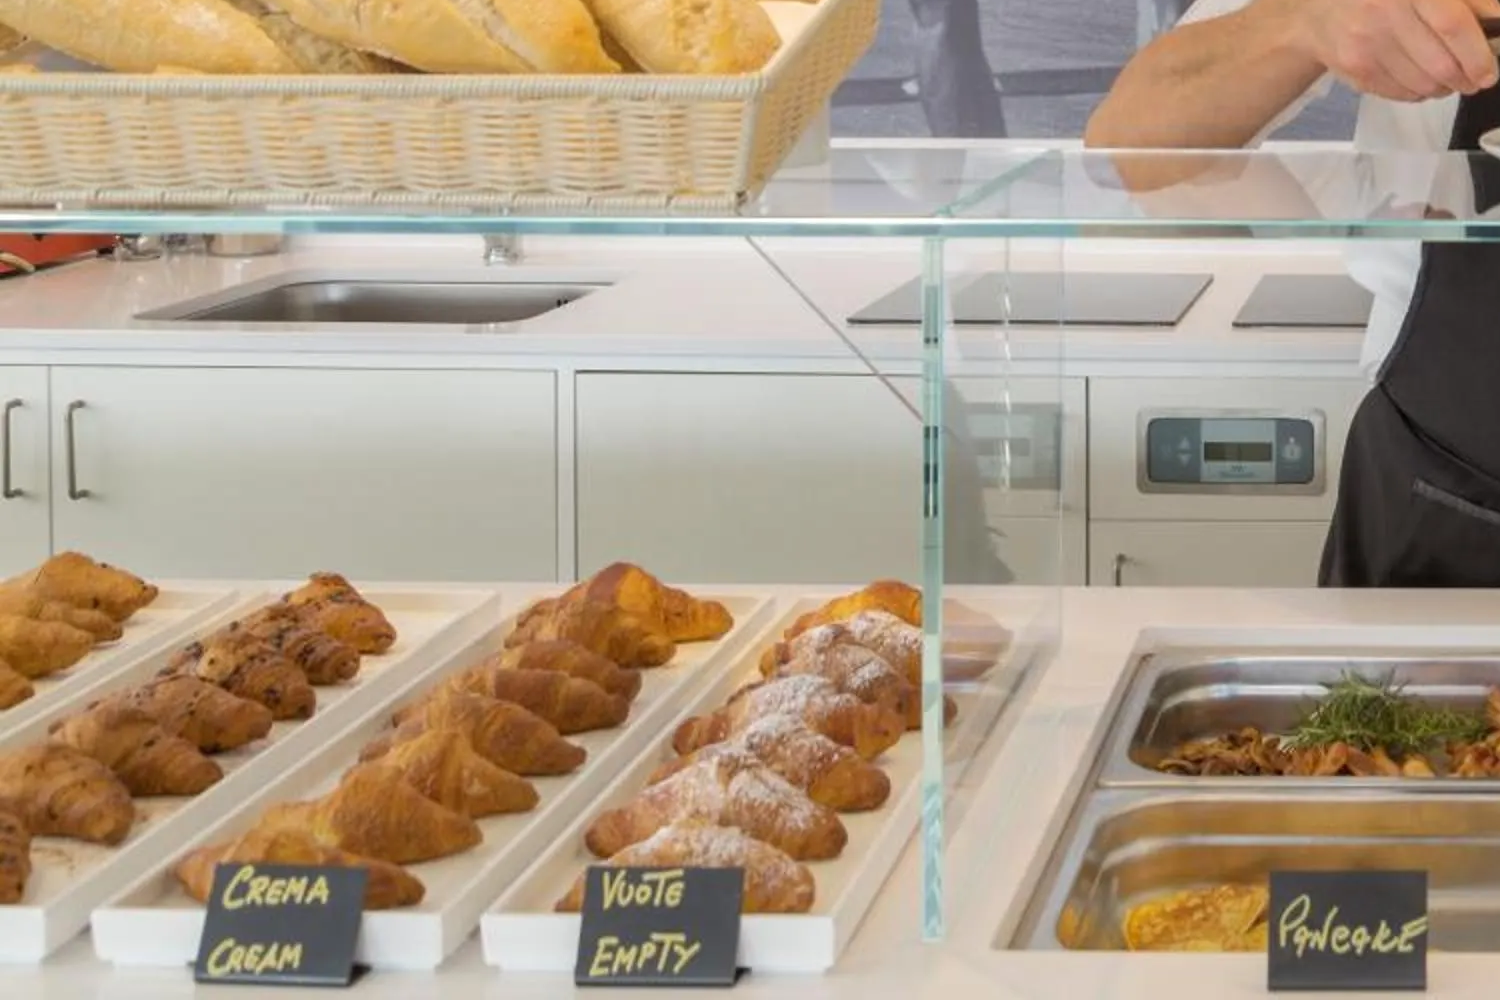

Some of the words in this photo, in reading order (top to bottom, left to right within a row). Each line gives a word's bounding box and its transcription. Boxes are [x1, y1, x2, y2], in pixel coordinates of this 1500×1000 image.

[222, 864, 330, 909] CREMA
[602, 868, 685, 911] VUOTE
[206, 937, 303, 977] CREAM
[588, 932, 702, 977] EMPTY
